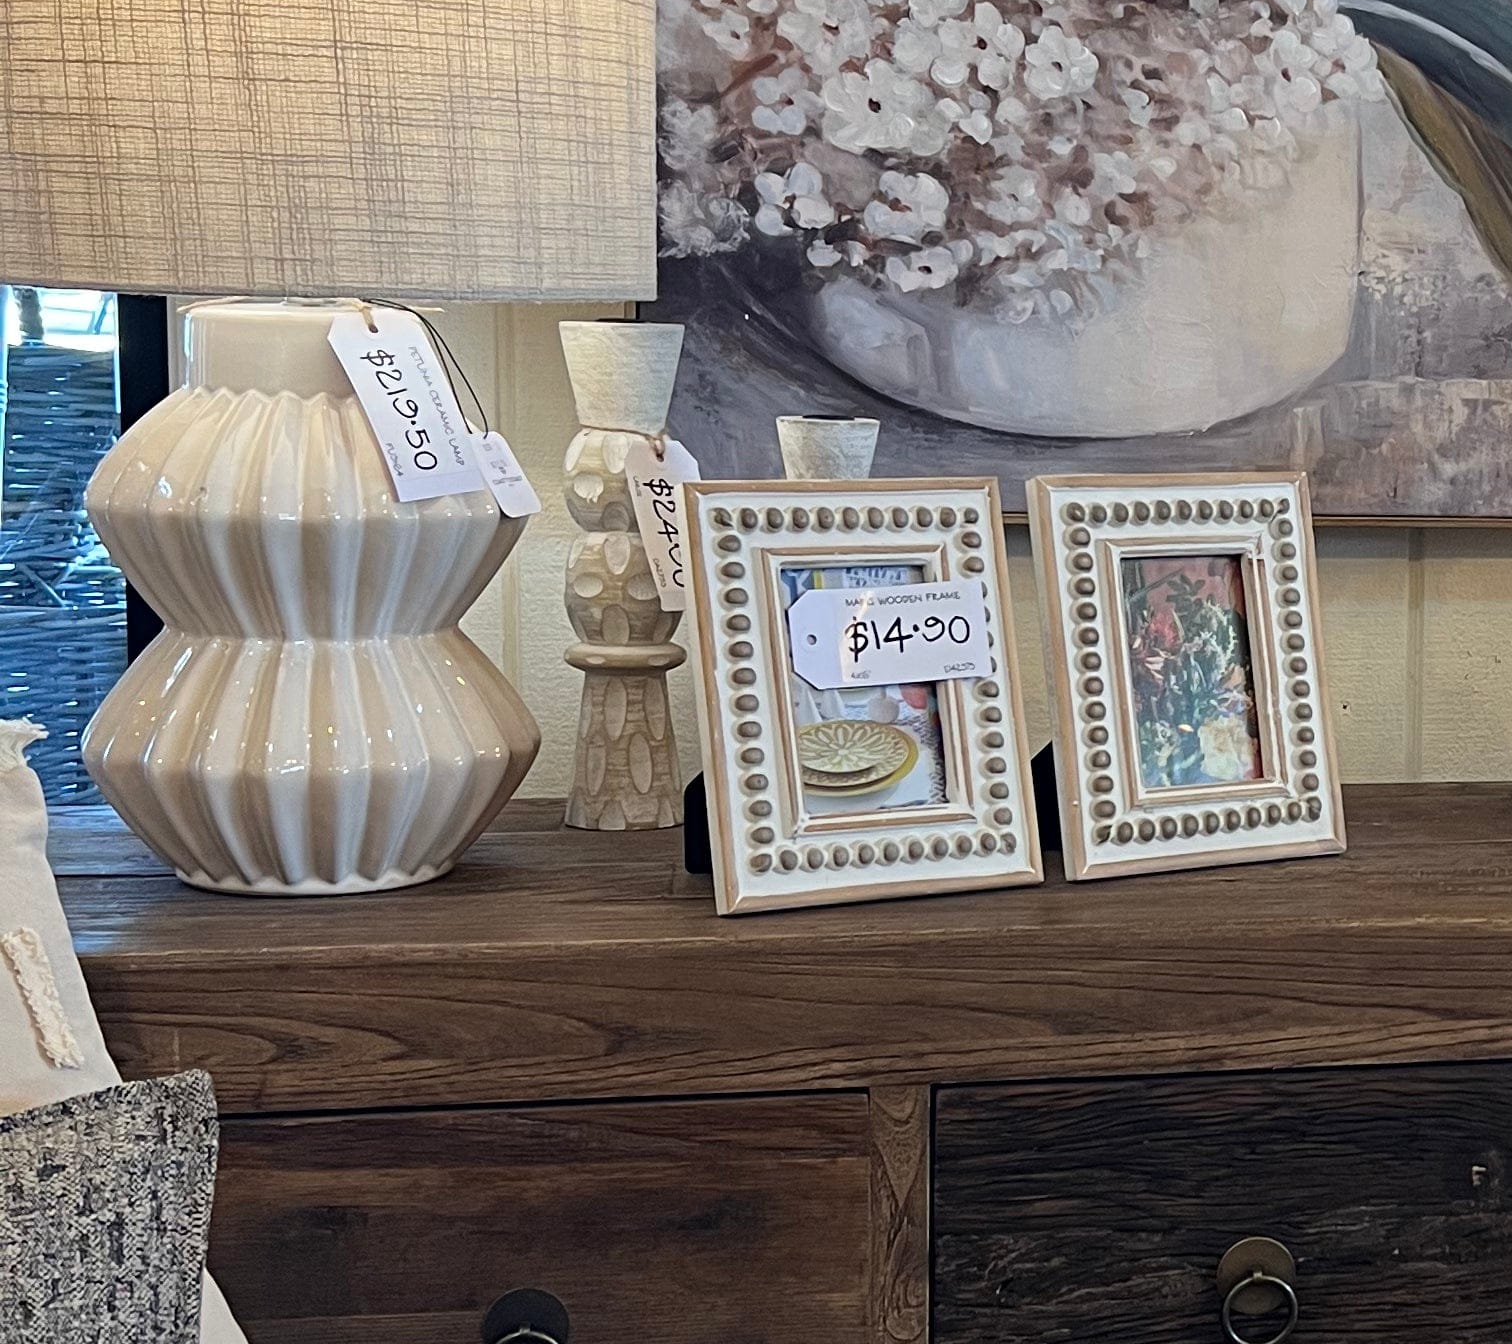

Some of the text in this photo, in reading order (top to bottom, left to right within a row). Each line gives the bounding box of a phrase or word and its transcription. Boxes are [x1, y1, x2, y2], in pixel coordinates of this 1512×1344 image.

[359, 349, 438, 471] $219.50
[428, 389, 456, 436] CERAMIC
[448, 437, 466, 467] LAMP
[878, 594, 922, 606] WOODEN
[925, 591, 960, 602] FRAME
[844, 614, 970, 663] $14.90
